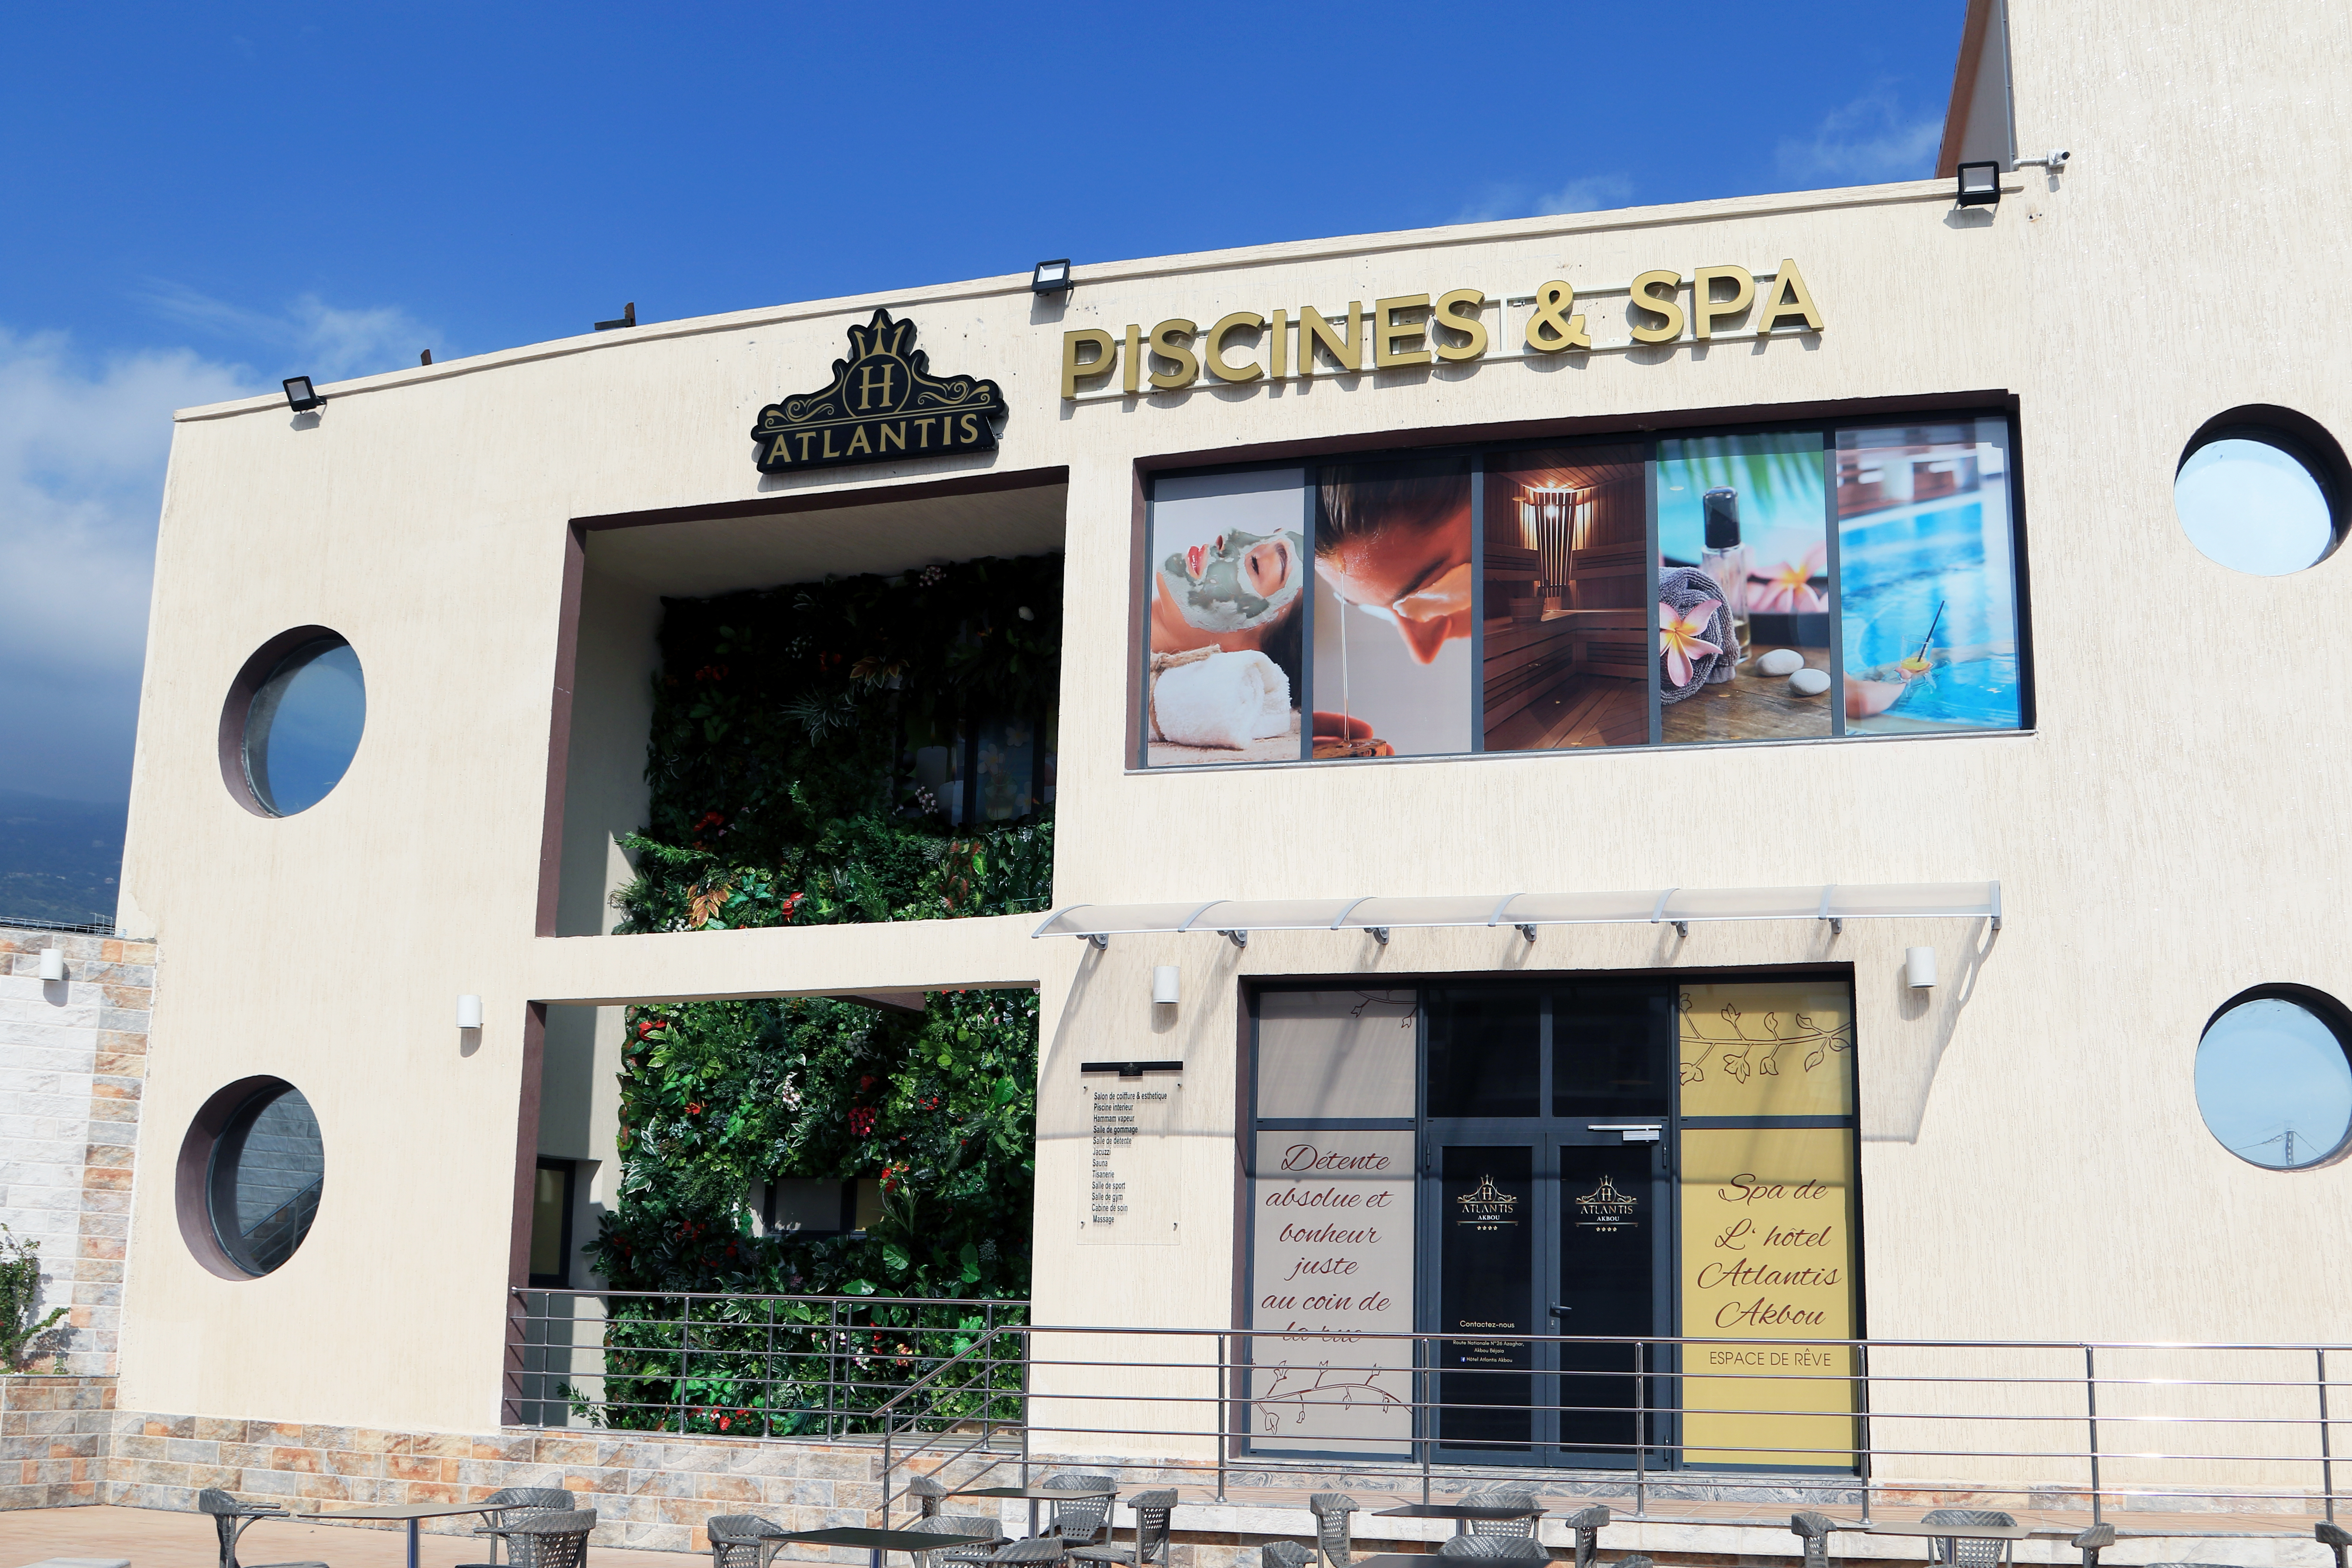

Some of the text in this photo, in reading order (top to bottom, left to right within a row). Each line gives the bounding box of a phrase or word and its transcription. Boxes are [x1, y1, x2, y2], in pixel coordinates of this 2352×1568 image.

[1061, 258, 1824, 401] PISCINES & SPA
[858, 364, 895, 410] H
[766, 413, 978, 465] ATLANTIS
[1109, 1092, 1115, 1100] de
[1142, 1091, 1167, 1101] esthetique
[1118, 1115, 1135, 1124] vapeur
[1093, 1125, 1105, 1133] Salle
[1114, 1126, 1138, 1135] gommage
[1113, 1136, 1132, 1144] détente
[1281, 1144, 1391, 1171] Détente
[1092, 1170, 1115, 1178] Tisanerie
[1092, 1181, 1104, 1189] Salle
[1112, 1182, 1125, 1191] sport
[1718, 1173, 1828, 1206] Spa de
[1092, 1192, 1123, 1202] Salle de gym
[1265, 1187, 1394, 1208] absolue et
[1482, 1187, 1492, 1200] H
[1602, 1188, 1611, 1201] H
[1092, 1204, 1128, 1212] Cabine de soin
[1462, 1204, 1513, 1213] ATLANTIS
[1580, 1205, 1633, 1214] ATLANTIS
[1093, 1215, 1115, 1225] Massage
[1280, 1223, 1382, 1243] bonheur
[1763, 1225, 1832, 1247] hôtel
[1283, 1257, 1359, 1281] juste
[1697, 1257, 1843, 1289] Atlantis
[1261, 1291, 1391, 1311] au coin de
[1715, 1296, 1826, 1328] Akbou
[1460, 1320, 1515, 1328] Contactez-nous
[1710, 1348, 1831, 1366] ESPACE DE RÊVE
